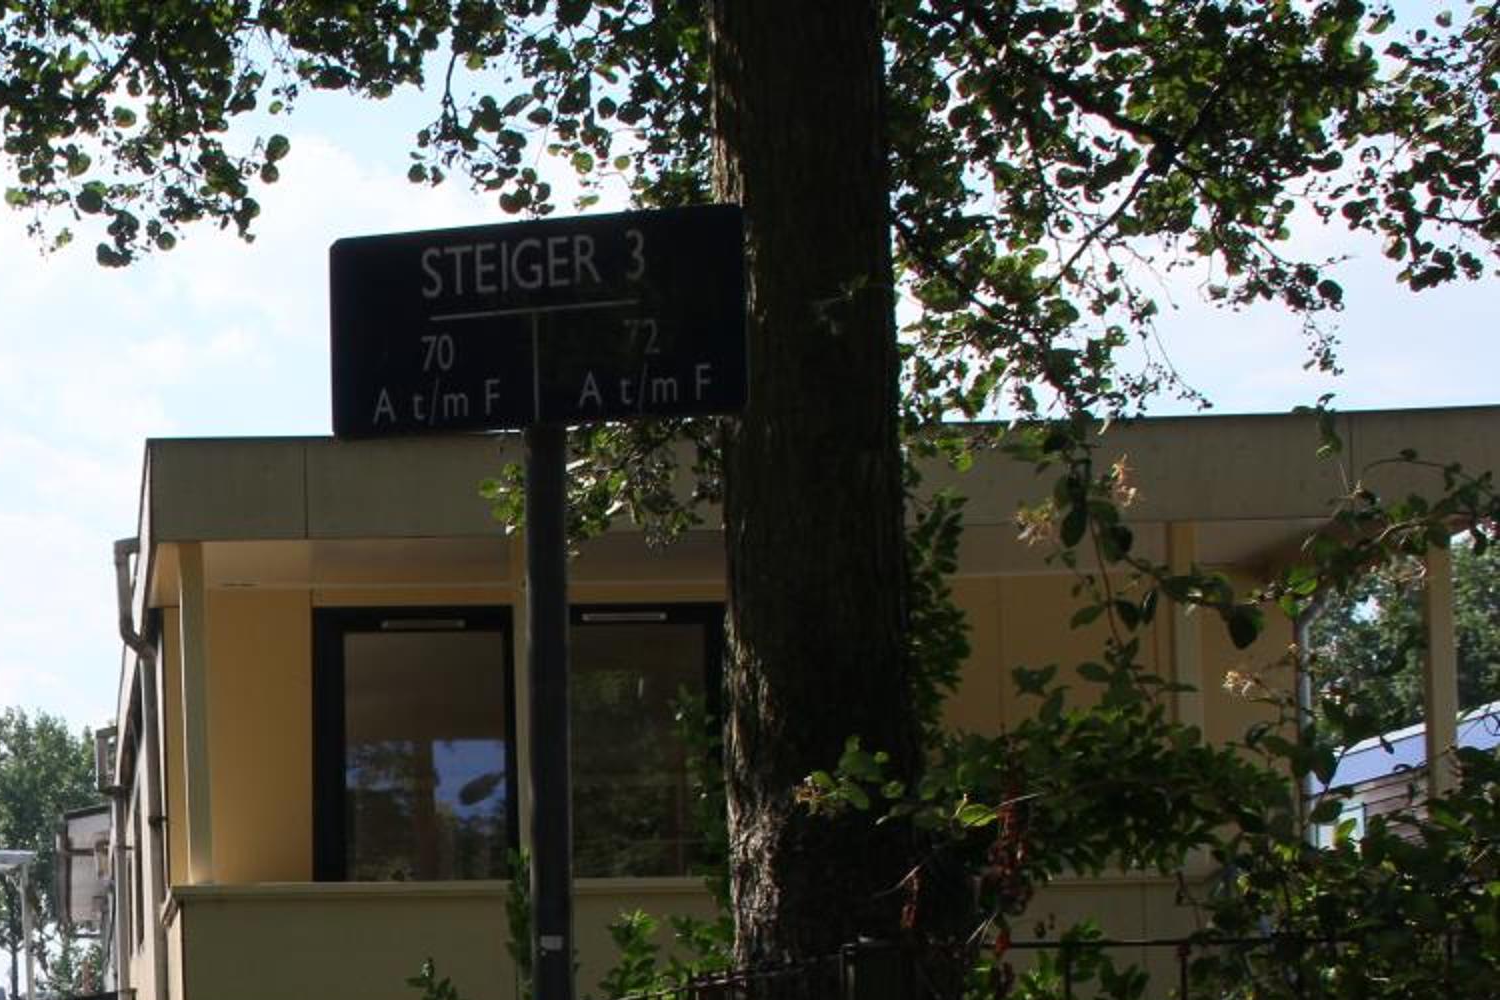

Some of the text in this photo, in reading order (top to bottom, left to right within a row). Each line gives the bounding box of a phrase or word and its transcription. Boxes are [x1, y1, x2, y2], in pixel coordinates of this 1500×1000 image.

[420, 229, 646, 299] STEIGER 3
[420, 334, 455, 372] 70
[623, 318, 661, 355] 72
[372, 378, 501, 426] A t/m F
[578, 362, 712, 415] A t/m F
